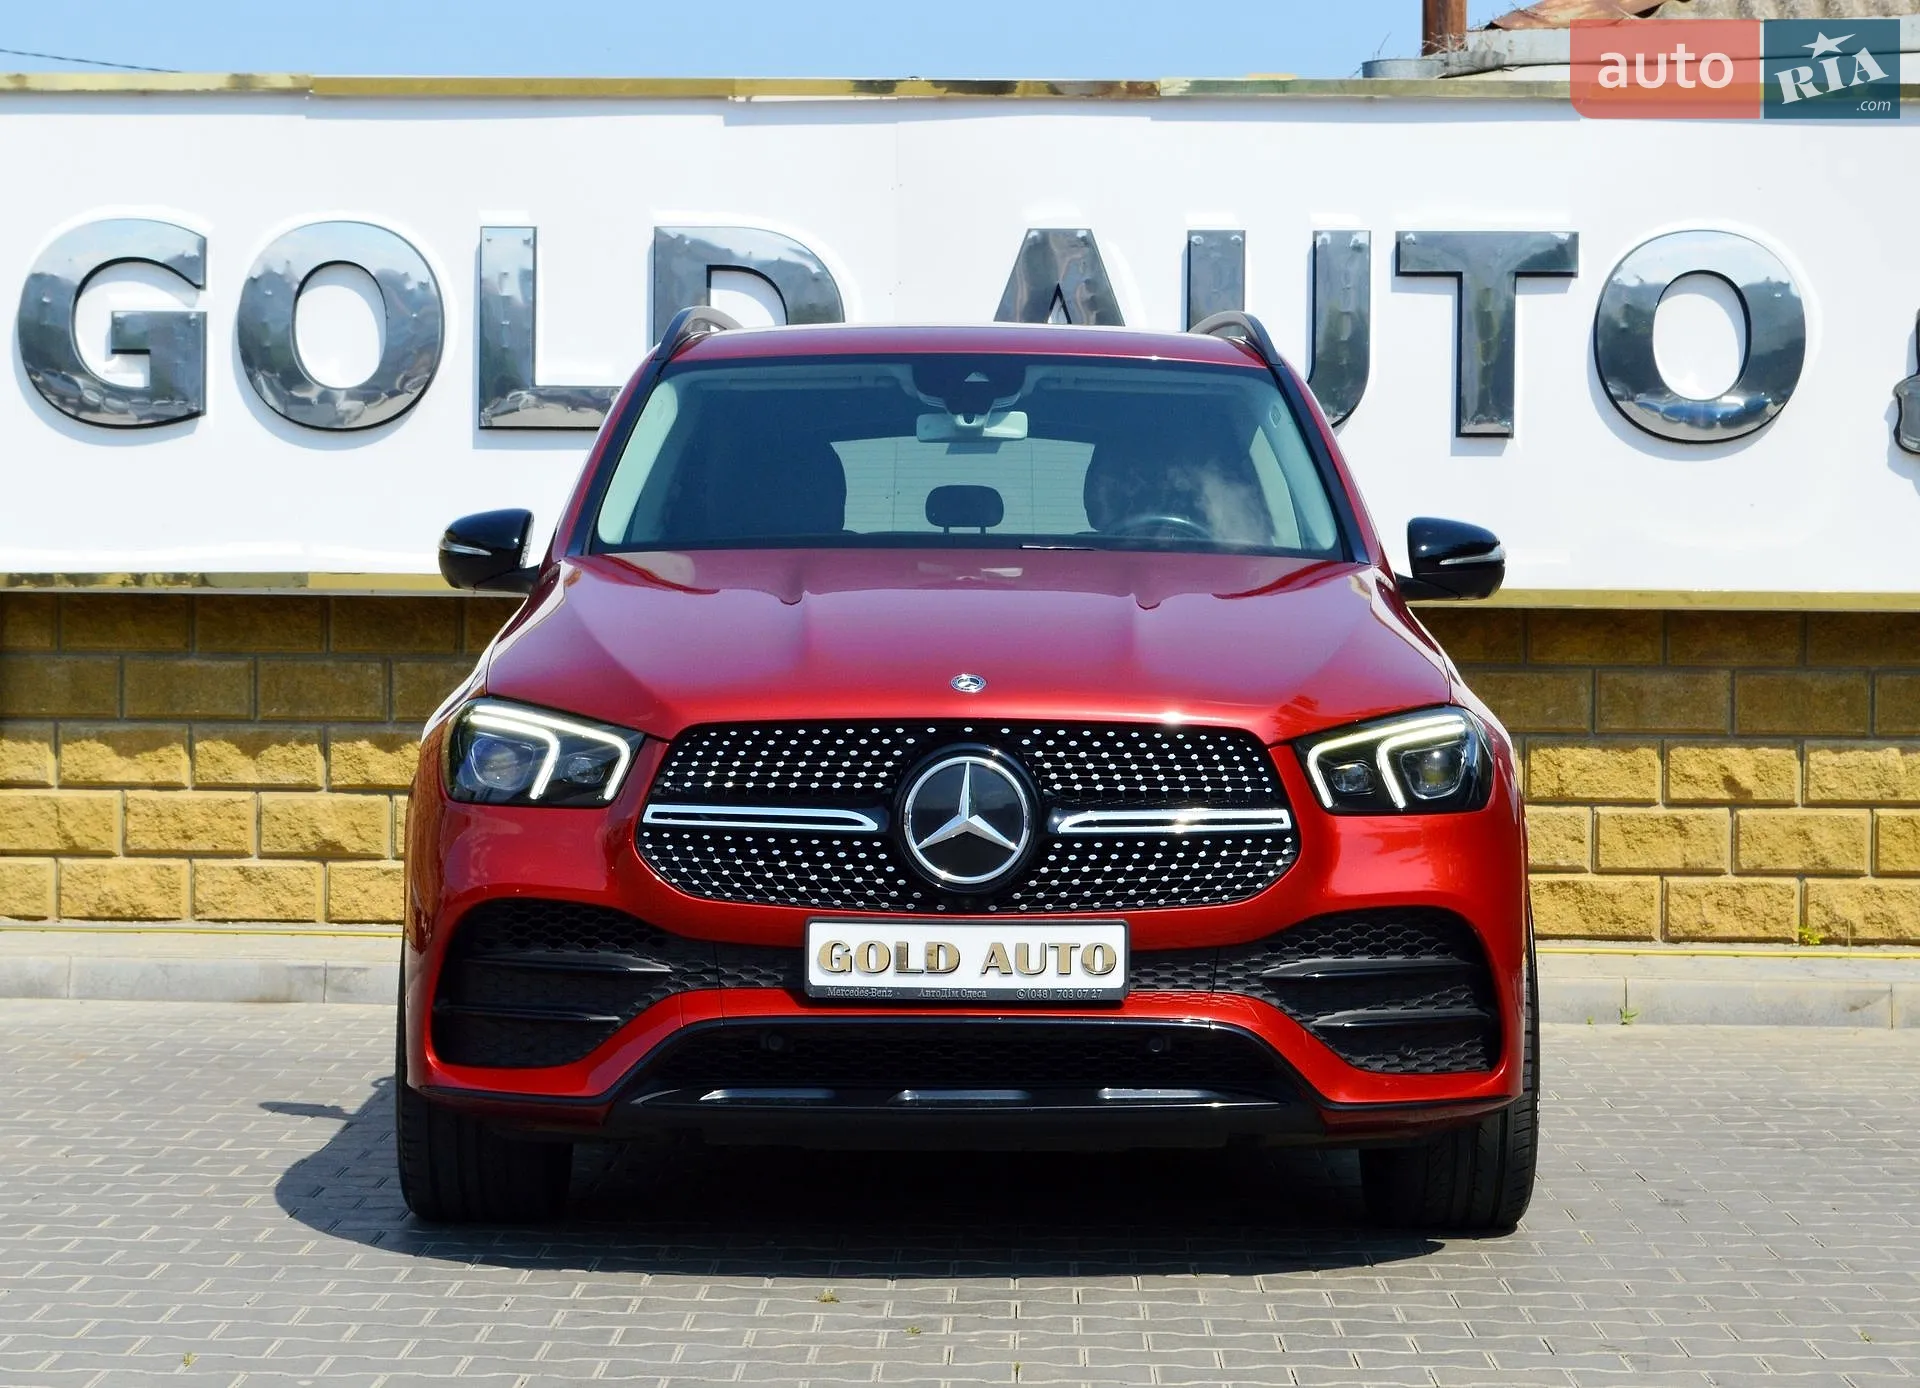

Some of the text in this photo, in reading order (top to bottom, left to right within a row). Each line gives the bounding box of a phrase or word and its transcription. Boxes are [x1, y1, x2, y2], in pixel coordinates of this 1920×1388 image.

[817, 940, 1117, 976] GOLD AUTO
[826, 985, 893, 998] Mercedes-Benz
[1056, 989, 1075, 999] 703
